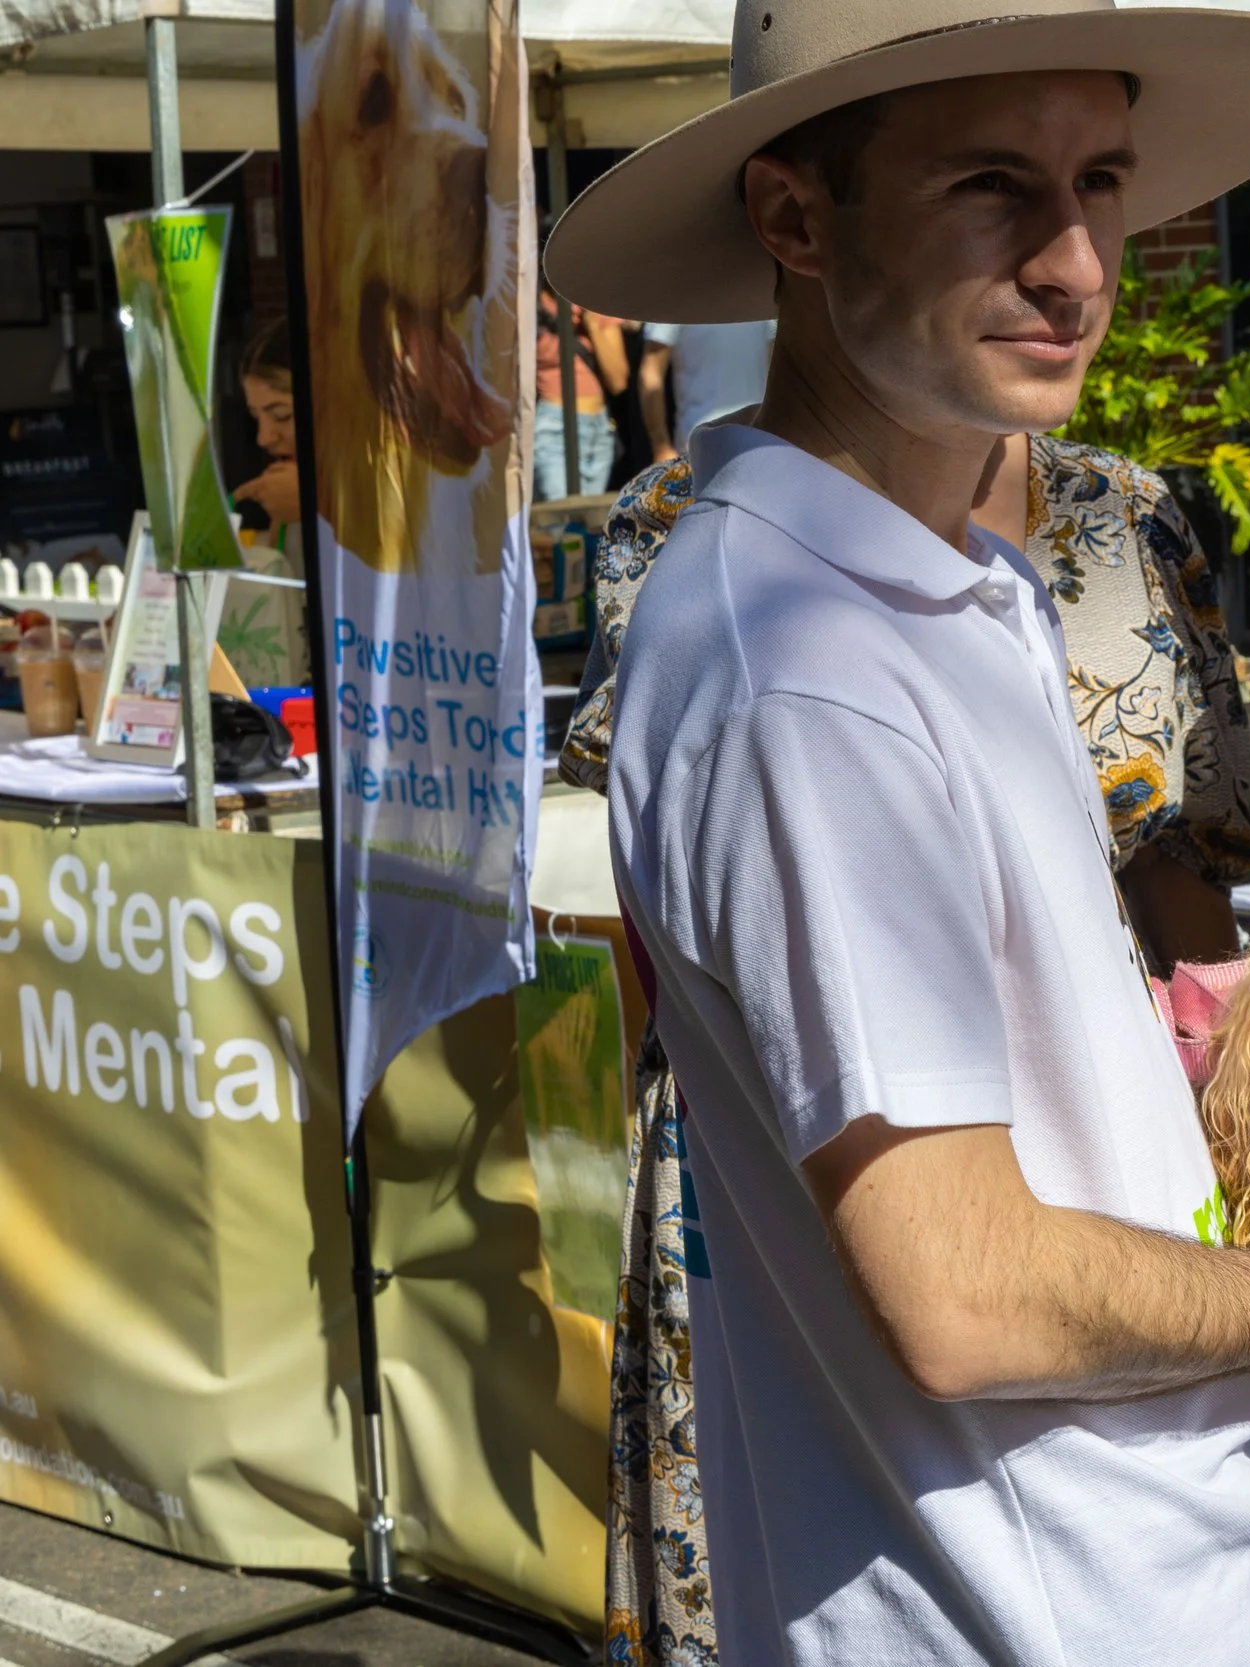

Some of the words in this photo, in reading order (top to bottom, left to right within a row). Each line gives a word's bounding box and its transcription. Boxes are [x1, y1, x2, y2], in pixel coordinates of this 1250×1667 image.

[170, 225, 207, 262] LIST
[336, 681, 429, 752] Seps
[43, 853, 285, 1008] Steps
[19, 983, 310, 1124] Mental
